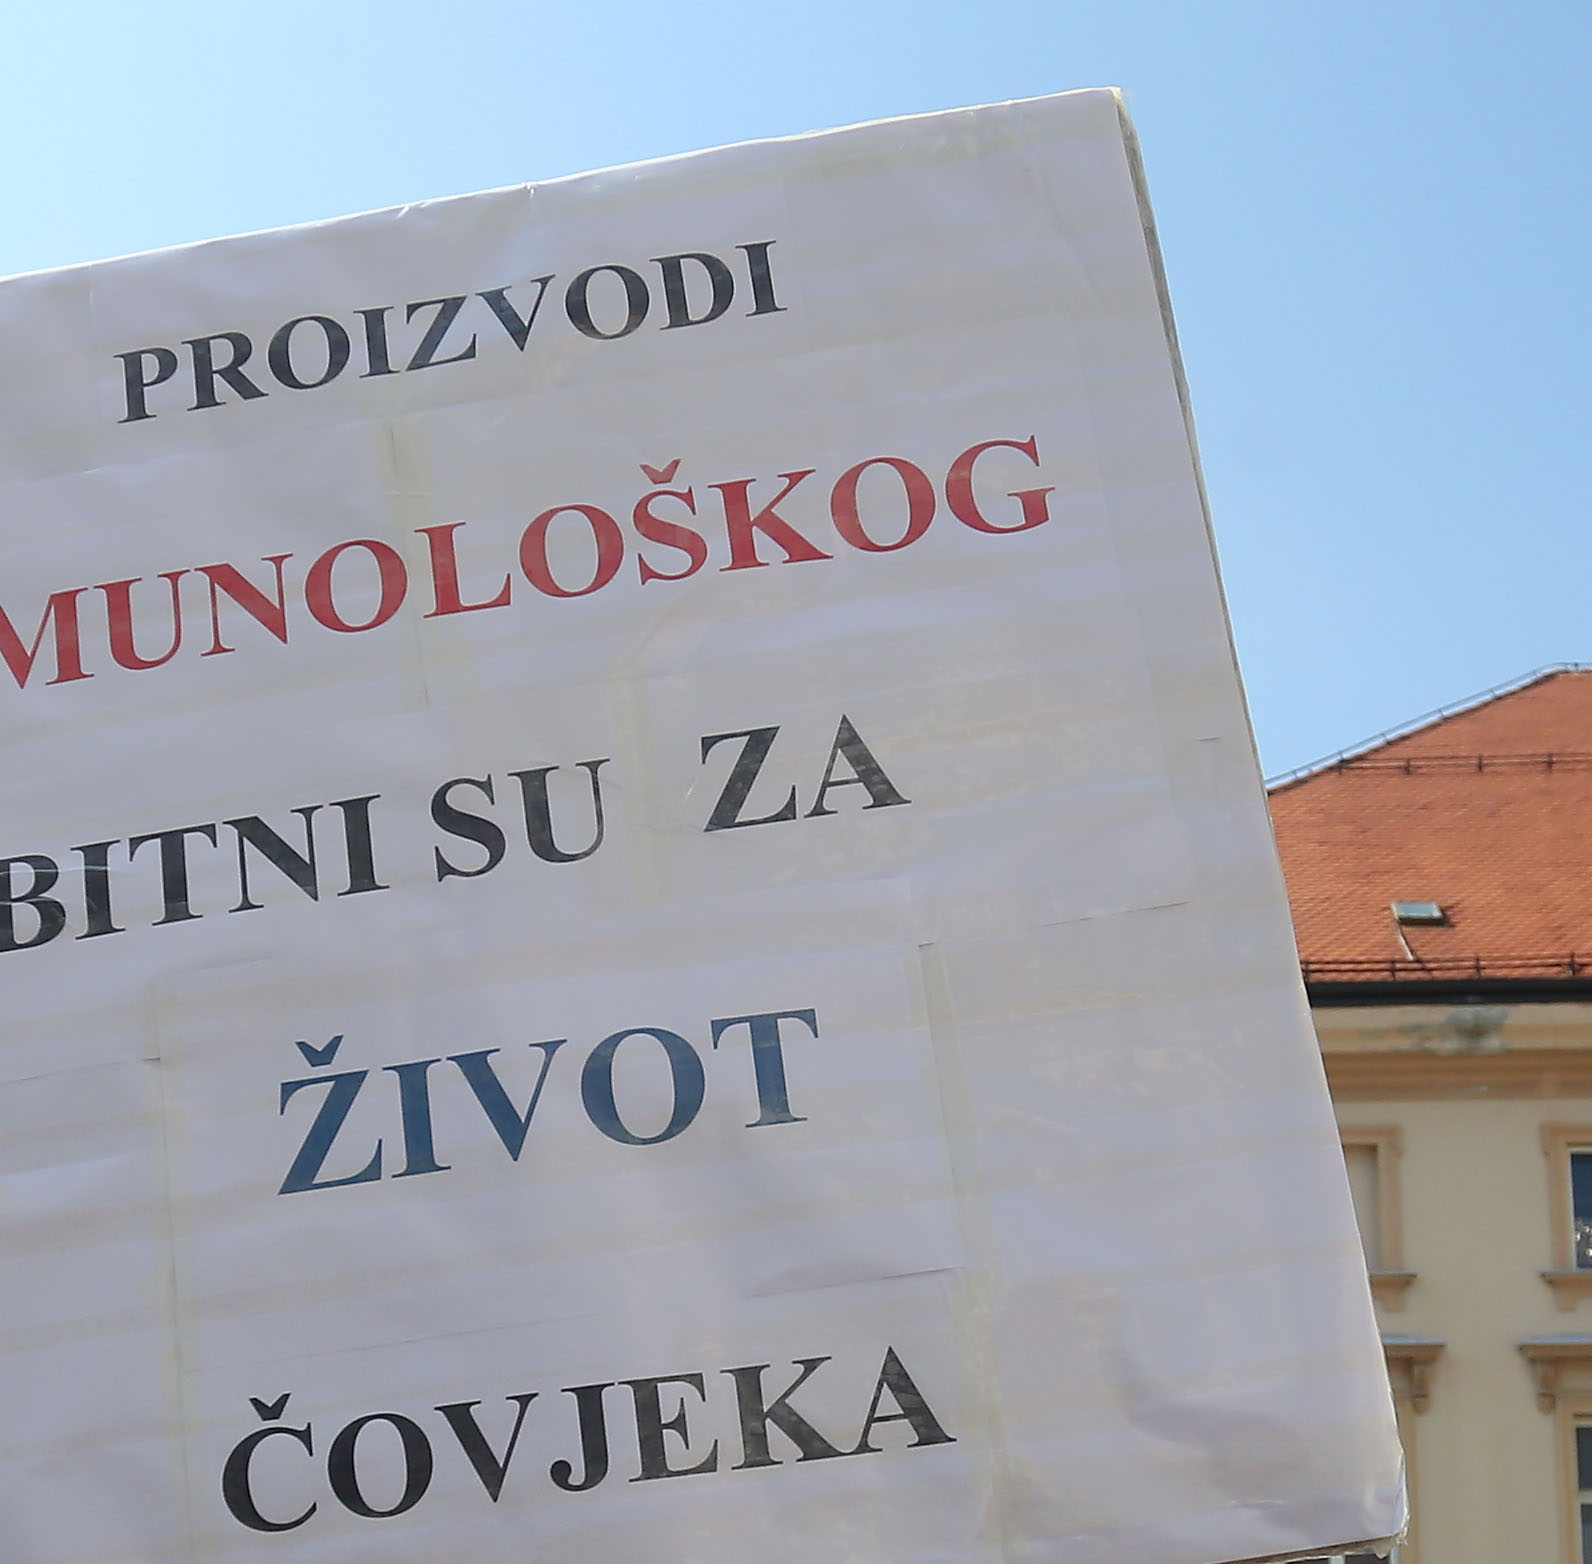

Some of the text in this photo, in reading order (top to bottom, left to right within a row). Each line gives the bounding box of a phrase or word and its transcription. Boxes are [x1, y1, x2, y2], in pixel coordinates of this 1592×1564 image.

[114, 240, 788, 424] PROIZVODI
[430, 758, 611, 883] SU
[700, 714, 912, 833] ZA
[278, 1008, 819, 1196] ŽIVOT
[222, 1345, 957, 1533] ČOVJEKA
